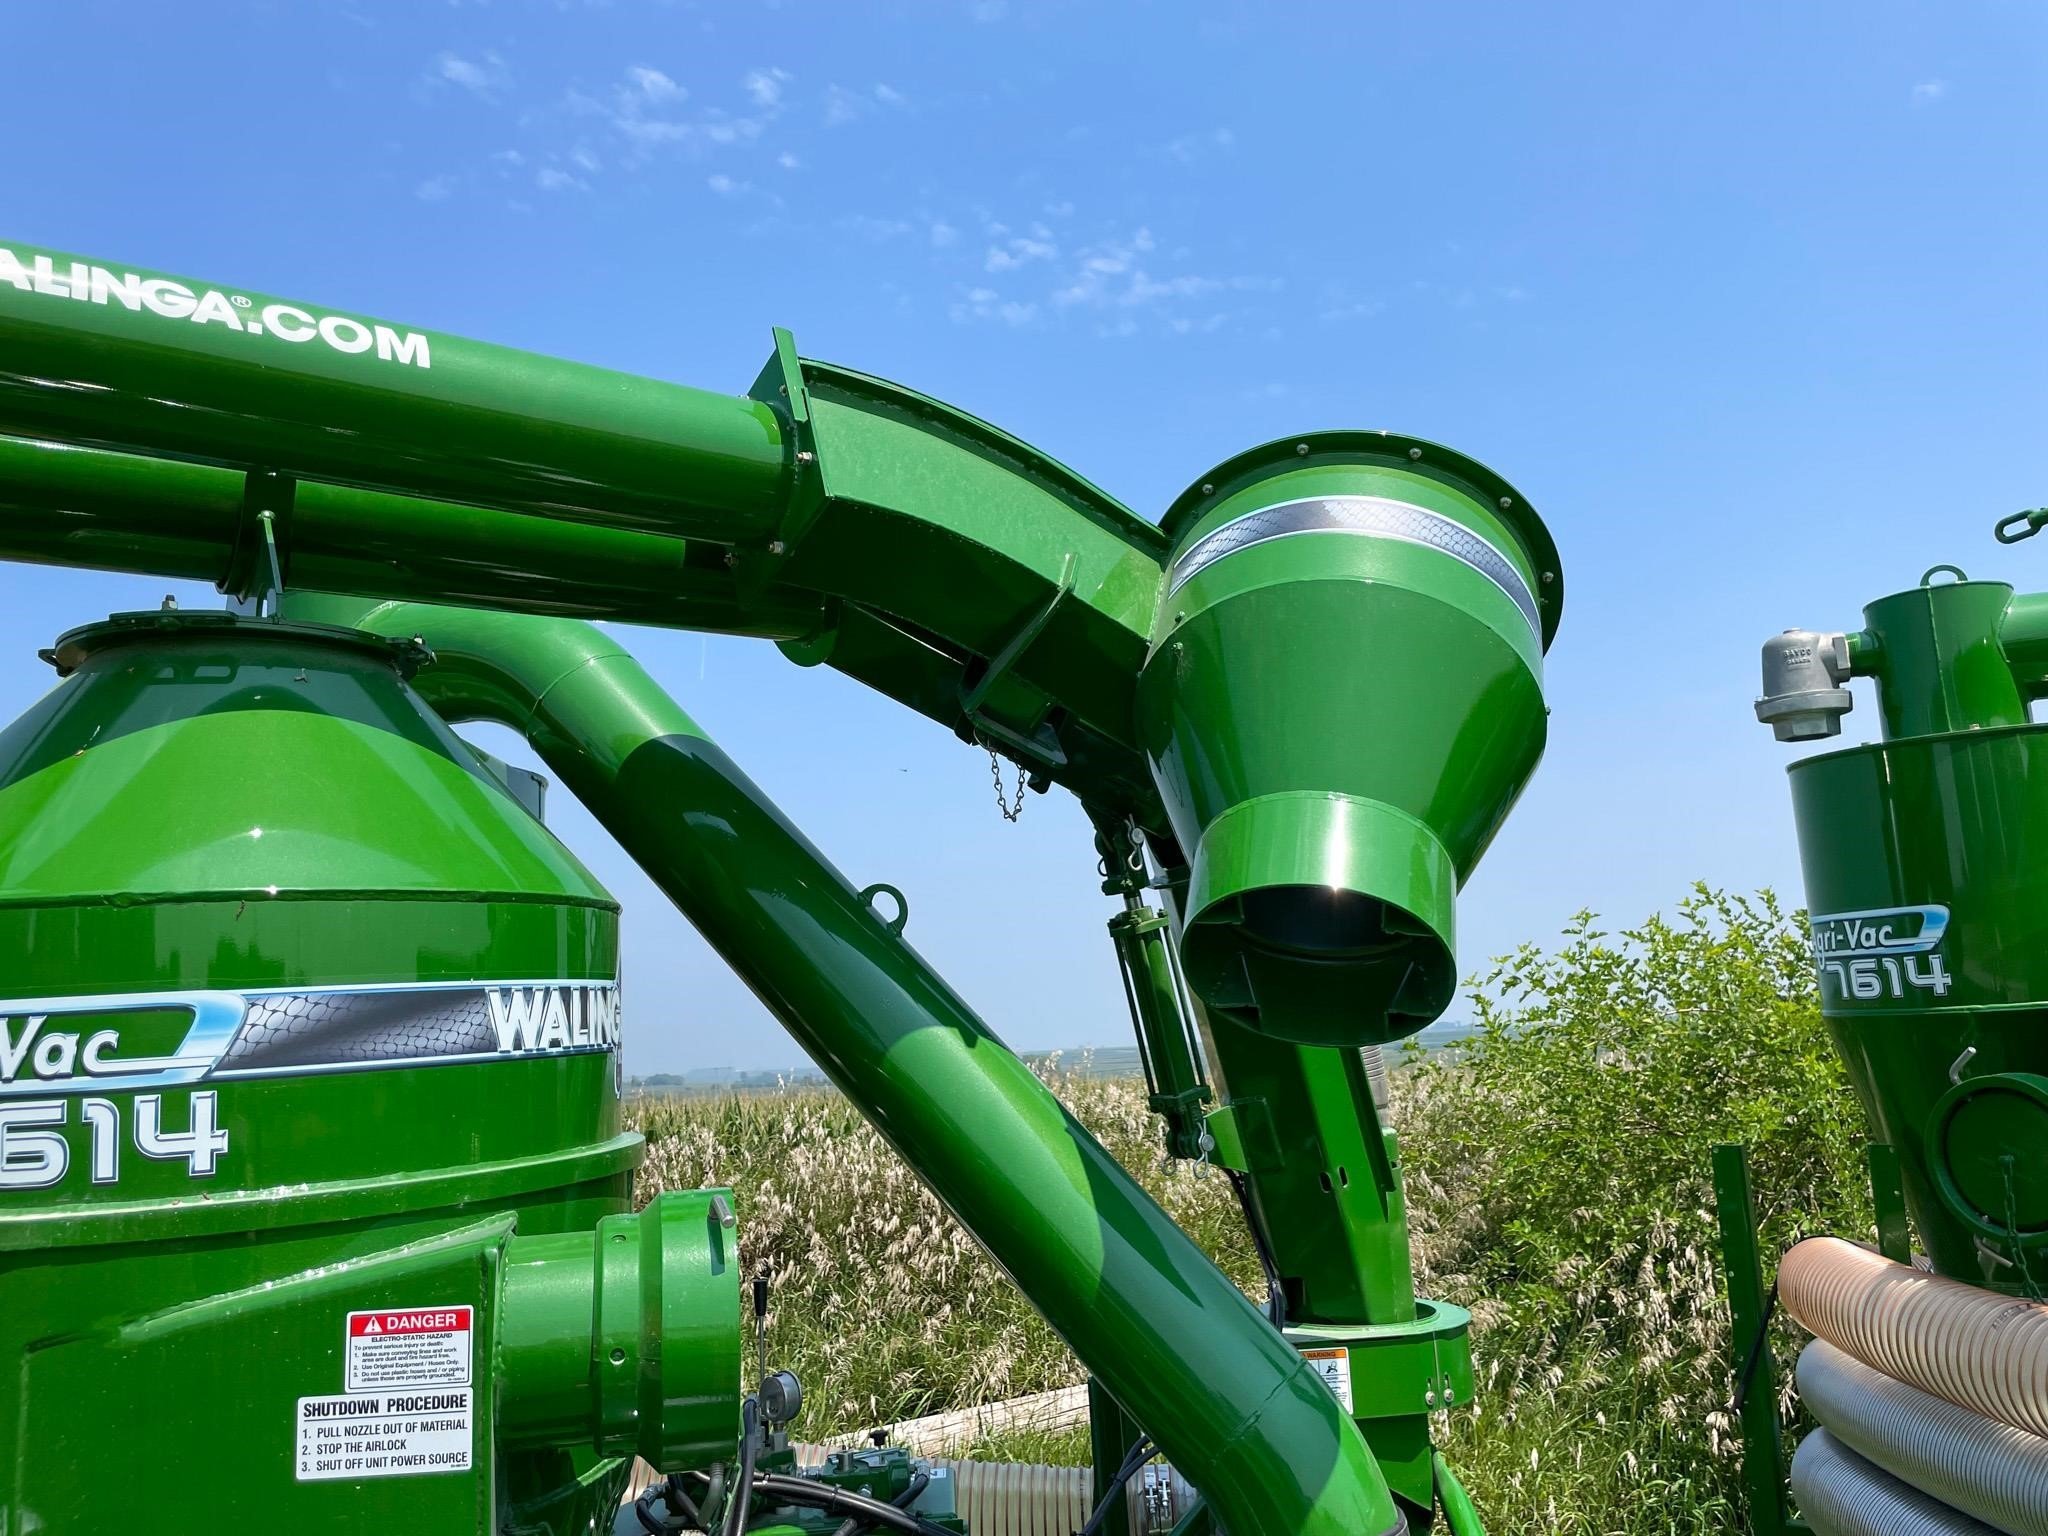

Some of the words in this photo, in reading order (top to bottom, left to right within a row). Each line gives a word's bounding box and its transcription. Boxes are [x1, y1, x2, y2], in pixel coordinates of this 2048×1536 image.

[1825, 953, 1951, 1000] 7614
[0, 1014, 122, 1084] Vac
[386, 1313, 457, 1330] DANGER
[371, 1334, 425, 1343] ELECTRO-STATIC
[304, 1399, 379, 1417] SHUTDOWN
[387, 1394, 467, 1412] PROCEDURE
[303, 1429, 311, 1439] 1.
[318, 1427, 341, 1438] PULL
[344, 1424, 380, 1436] NOZZLE
[383, 1423, 403, 1434] OUT
[405, 1422, 417, 1433] OF
[420, 1419, 467, 1432] MATERIAL
[302, 1445, 311, 1455] 2.
[317, 1443, 342, 1454] STOP
[344, 1442, 362, 1453] THE
[365, 1439, 406, 1452] AIRLOCK
[302, 1462, 310, 1472] 3.
[317, 1459, 342, 1471] SHUT
[345, 1458, 363, 1469] OFF
[366, 1457, 388, 1468] UNIT
[391, 1455, 425, 1467] POWER
[429, 1452, 467, 1464] SOURCE
